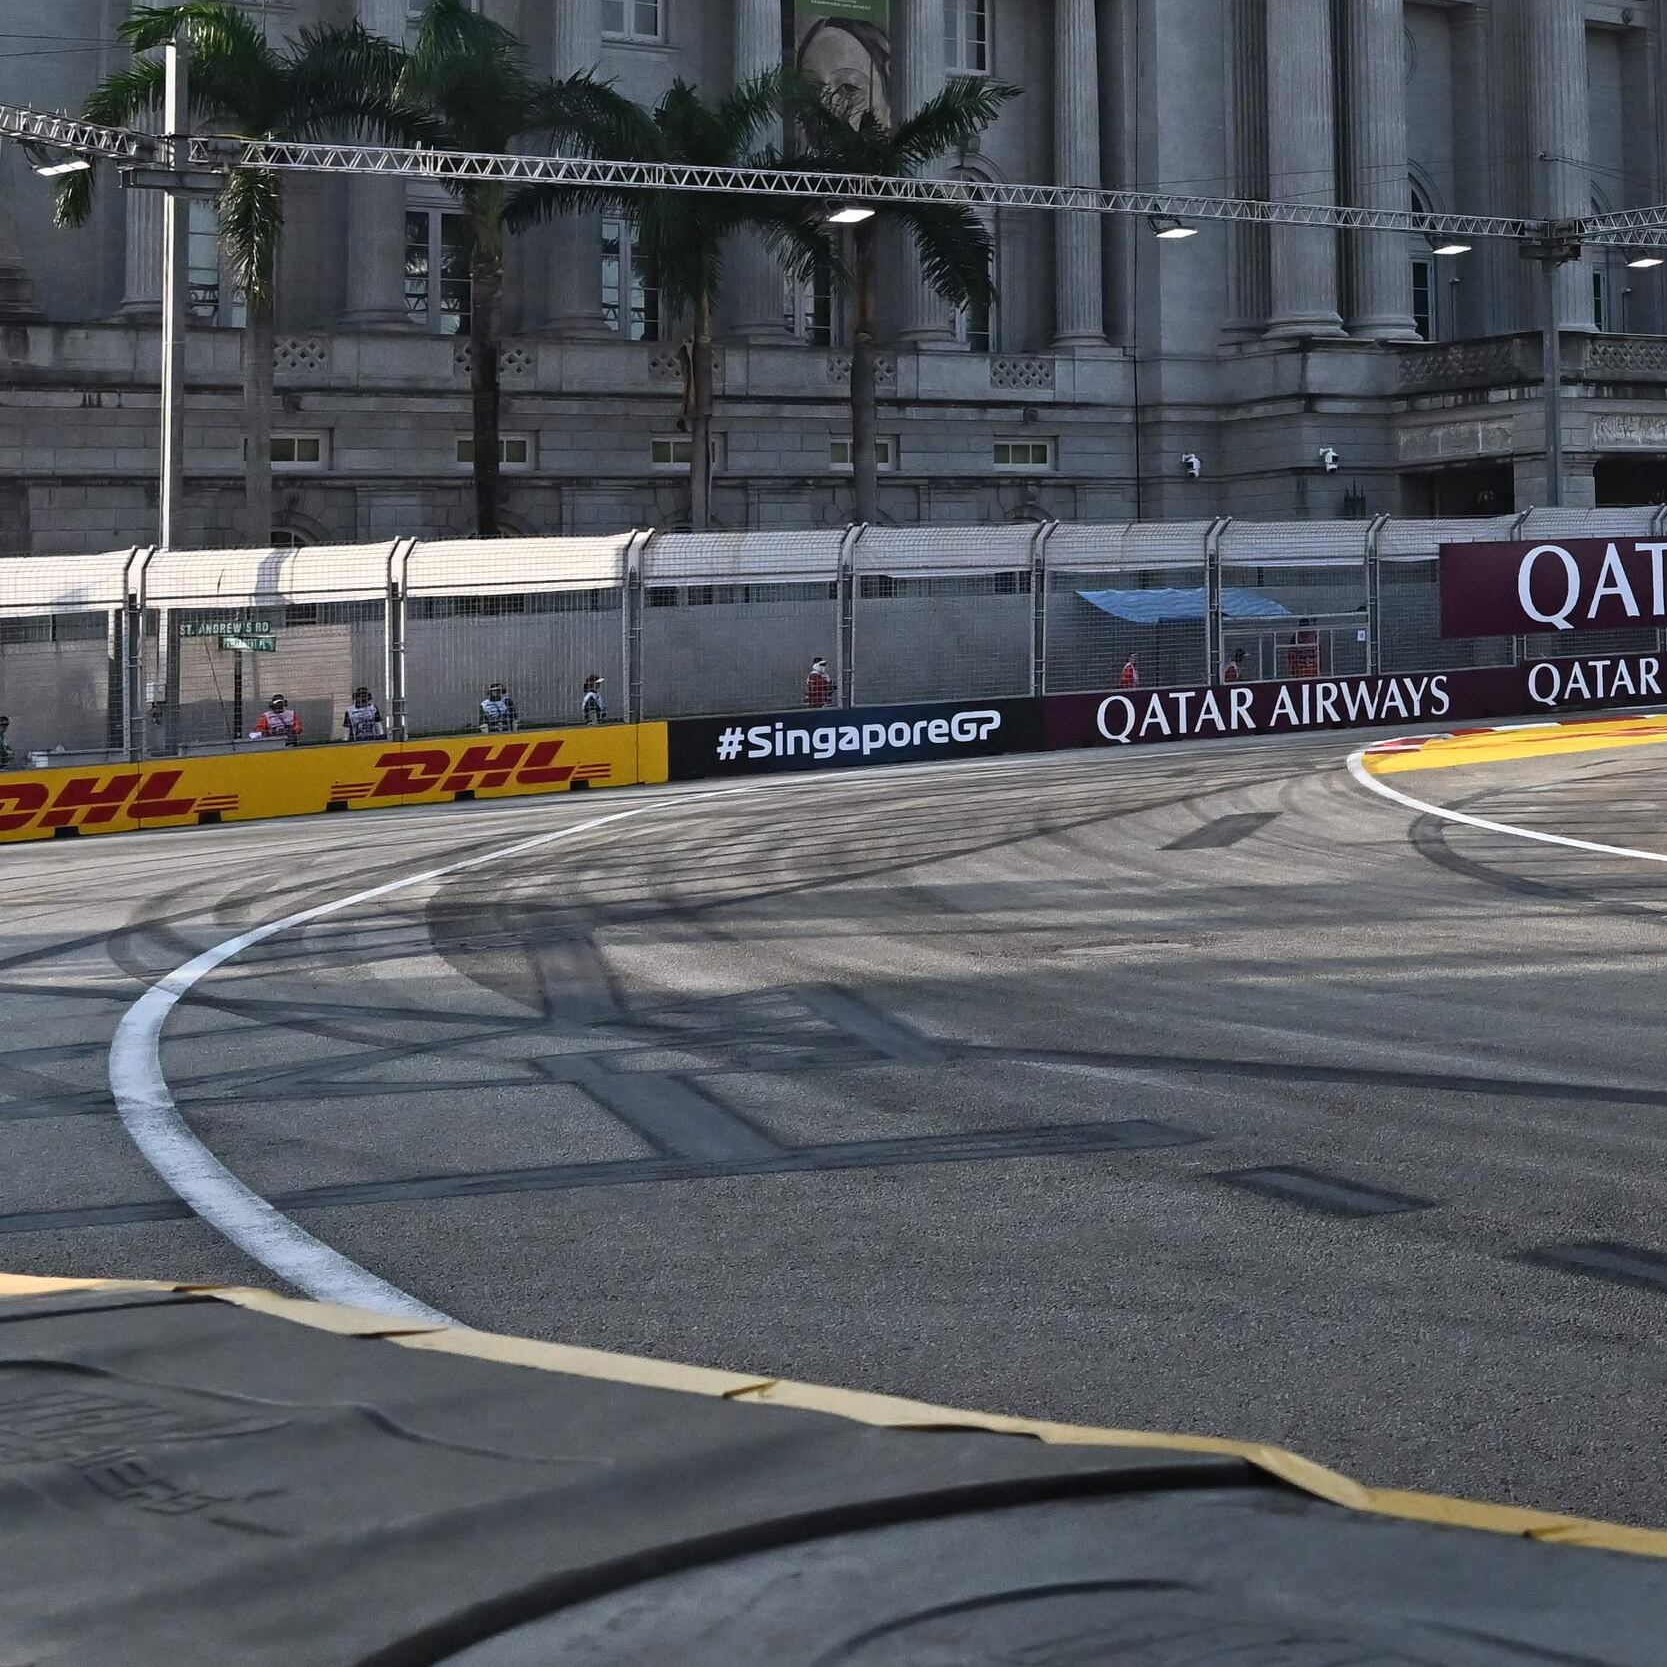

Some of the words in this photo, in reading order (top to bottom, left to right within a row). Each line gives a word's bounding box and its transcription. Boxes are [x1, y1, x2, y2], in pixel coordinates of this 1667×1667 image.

[180, 624, 195, 635] ST.
[199, 622, 252, 635] ANDREW'S
[255, 621, 269, 633] RD
[1528, 658, 1662, 706] QATAR
[1097, 687, 1256, 744] QATAR
[1271, 675, 1450, 726] AIRWAYS
[716, 710, 1001, 760] #SingaporeGP
[372, 740, 577, 797] DHL
